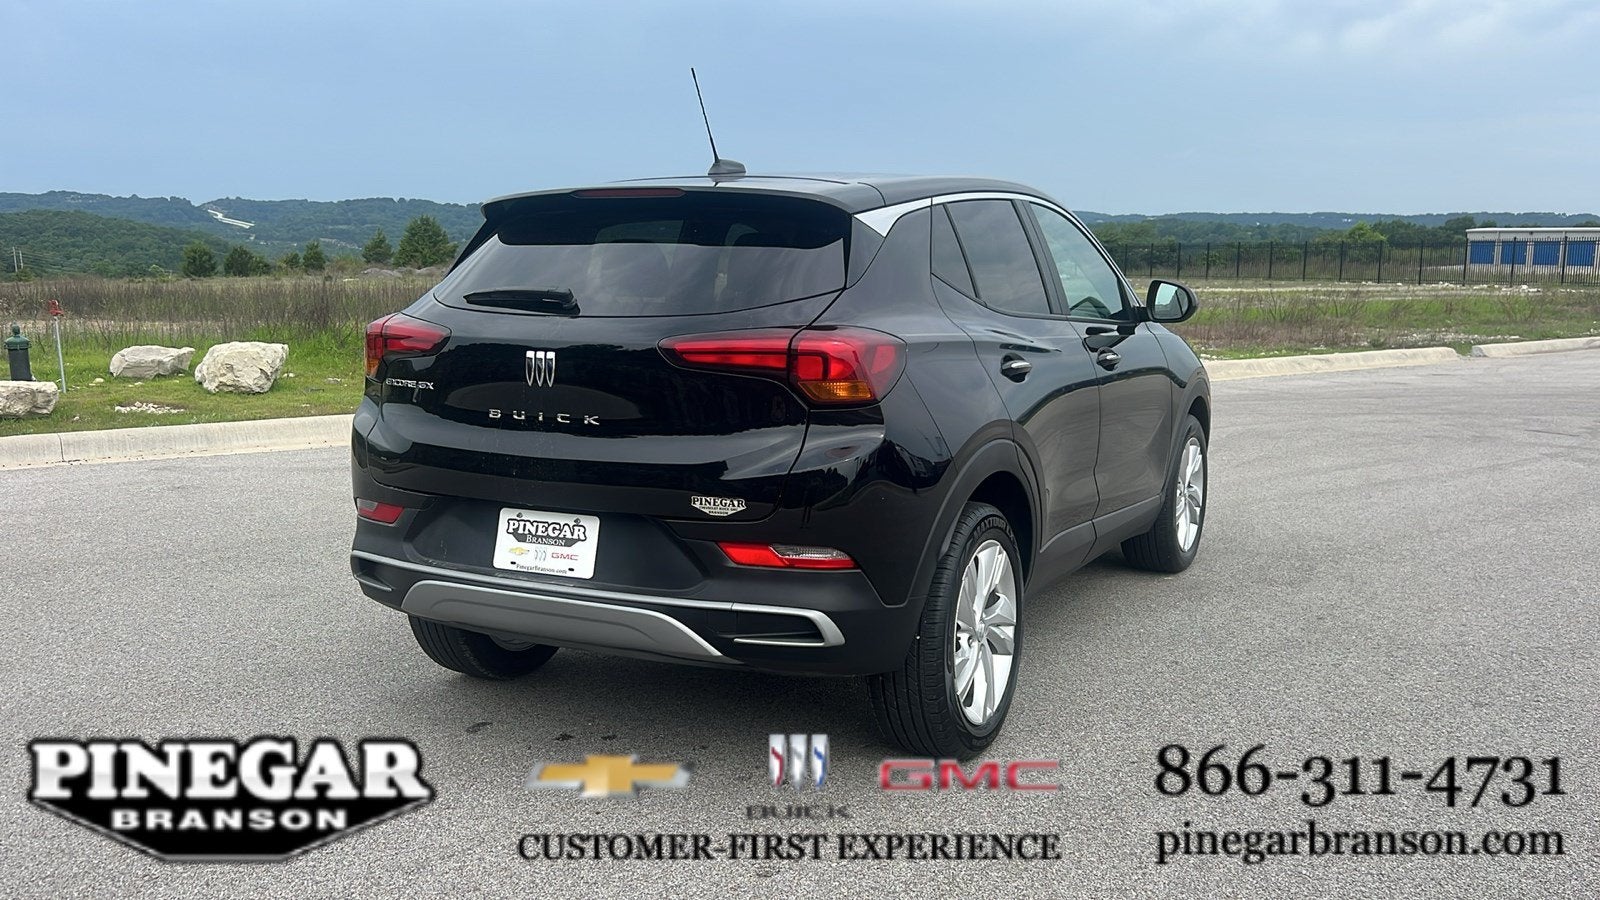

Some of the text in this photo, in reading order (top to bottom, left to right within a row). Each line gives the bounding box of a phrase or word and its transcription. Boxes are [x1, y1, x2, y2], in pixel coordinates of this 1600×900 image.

[385, 378, 434, 390] ENCORE GX
[488, 408, 600, 426] BUICK
[692, 496, 746, 508] PINEGAR
[507, 518, 587, 541] PINEGAR
[525, 534, 566, 546] BRANSON
[551, 552, 579, 561] GMC
